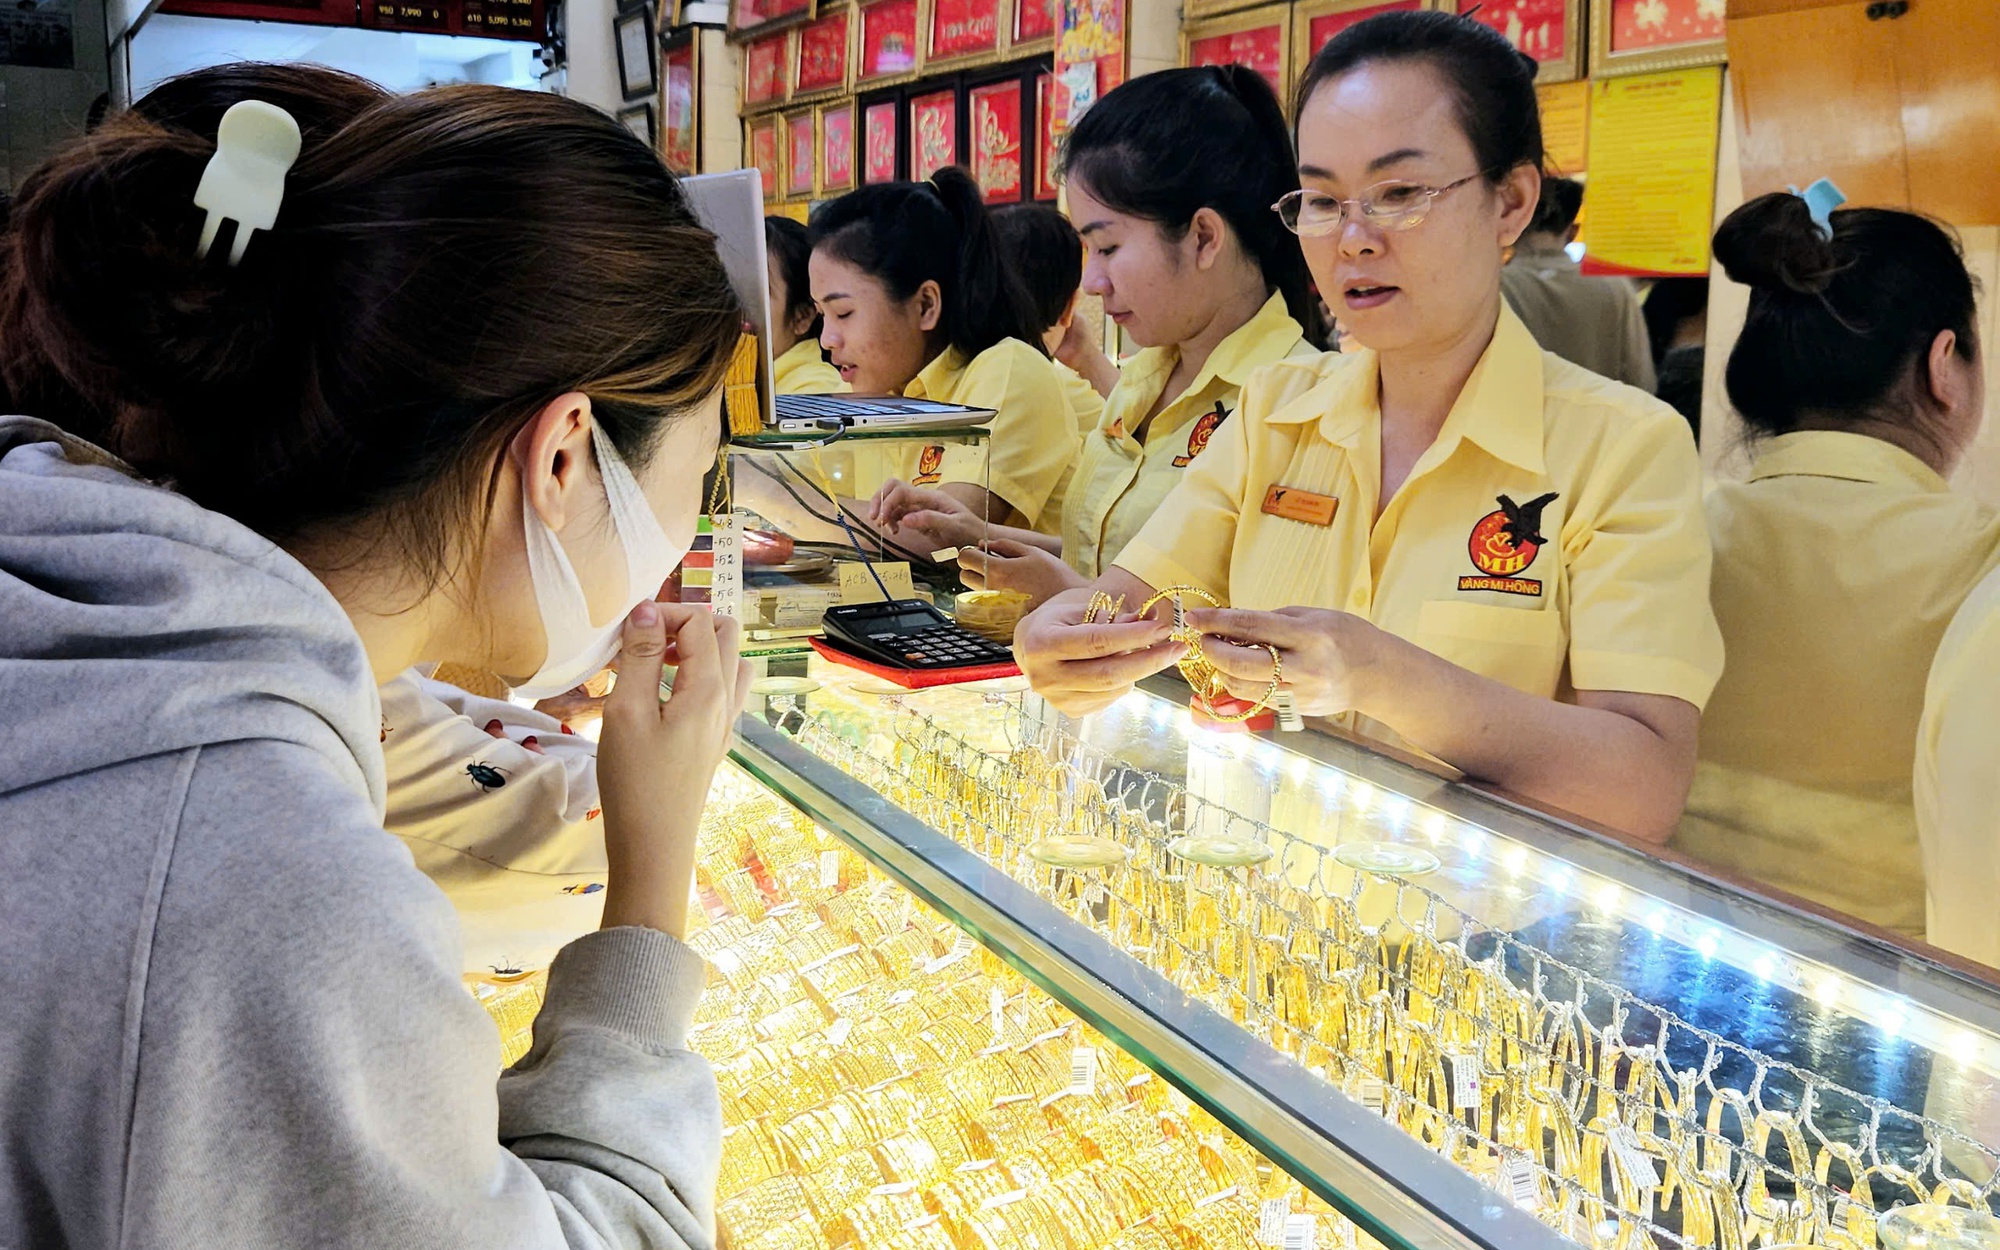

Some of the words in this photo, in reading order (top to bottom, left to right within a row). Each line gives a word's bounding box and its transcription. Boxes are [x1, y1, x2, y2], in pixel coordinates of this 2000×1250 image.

[467, 13, 482, 23] 610
[1478, 552, 1526, 572] MH
[1461, 577, 1488, 589] VÀNG
